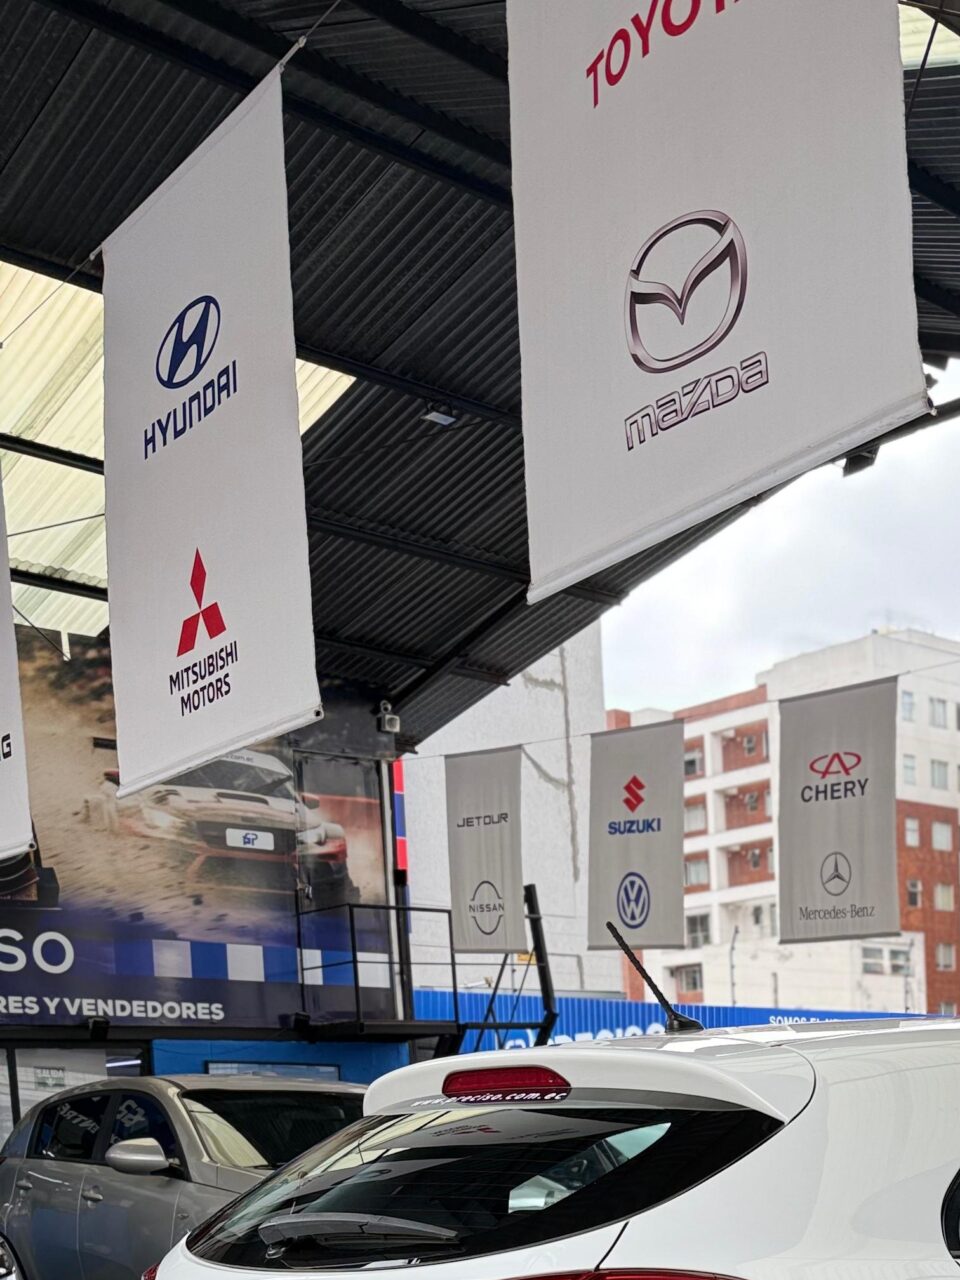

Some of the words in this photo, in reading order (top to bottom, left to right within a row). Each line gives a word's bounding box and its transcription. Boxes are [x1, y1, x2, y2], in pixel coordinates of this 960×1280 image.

[586, 0, 739, 108] TOYO
[143, 360, 238, 459] HYUNDAI
[169, 641, 238, 695] MITSUBISHI
[181, 673, 231, 717] MOTORS
[801, 778, 869, 803] CHERY
[457, 812, 509, 828] JETOUR
[608, 818, 661, 836] SUZUKI
[469, 902, 505, 913] NISSAN
[800, 904, 875, 921] Mercedes-Benz
[43, 997, 60, 1015] Y
[63, 998, 225, 1020] VENDEDORES
